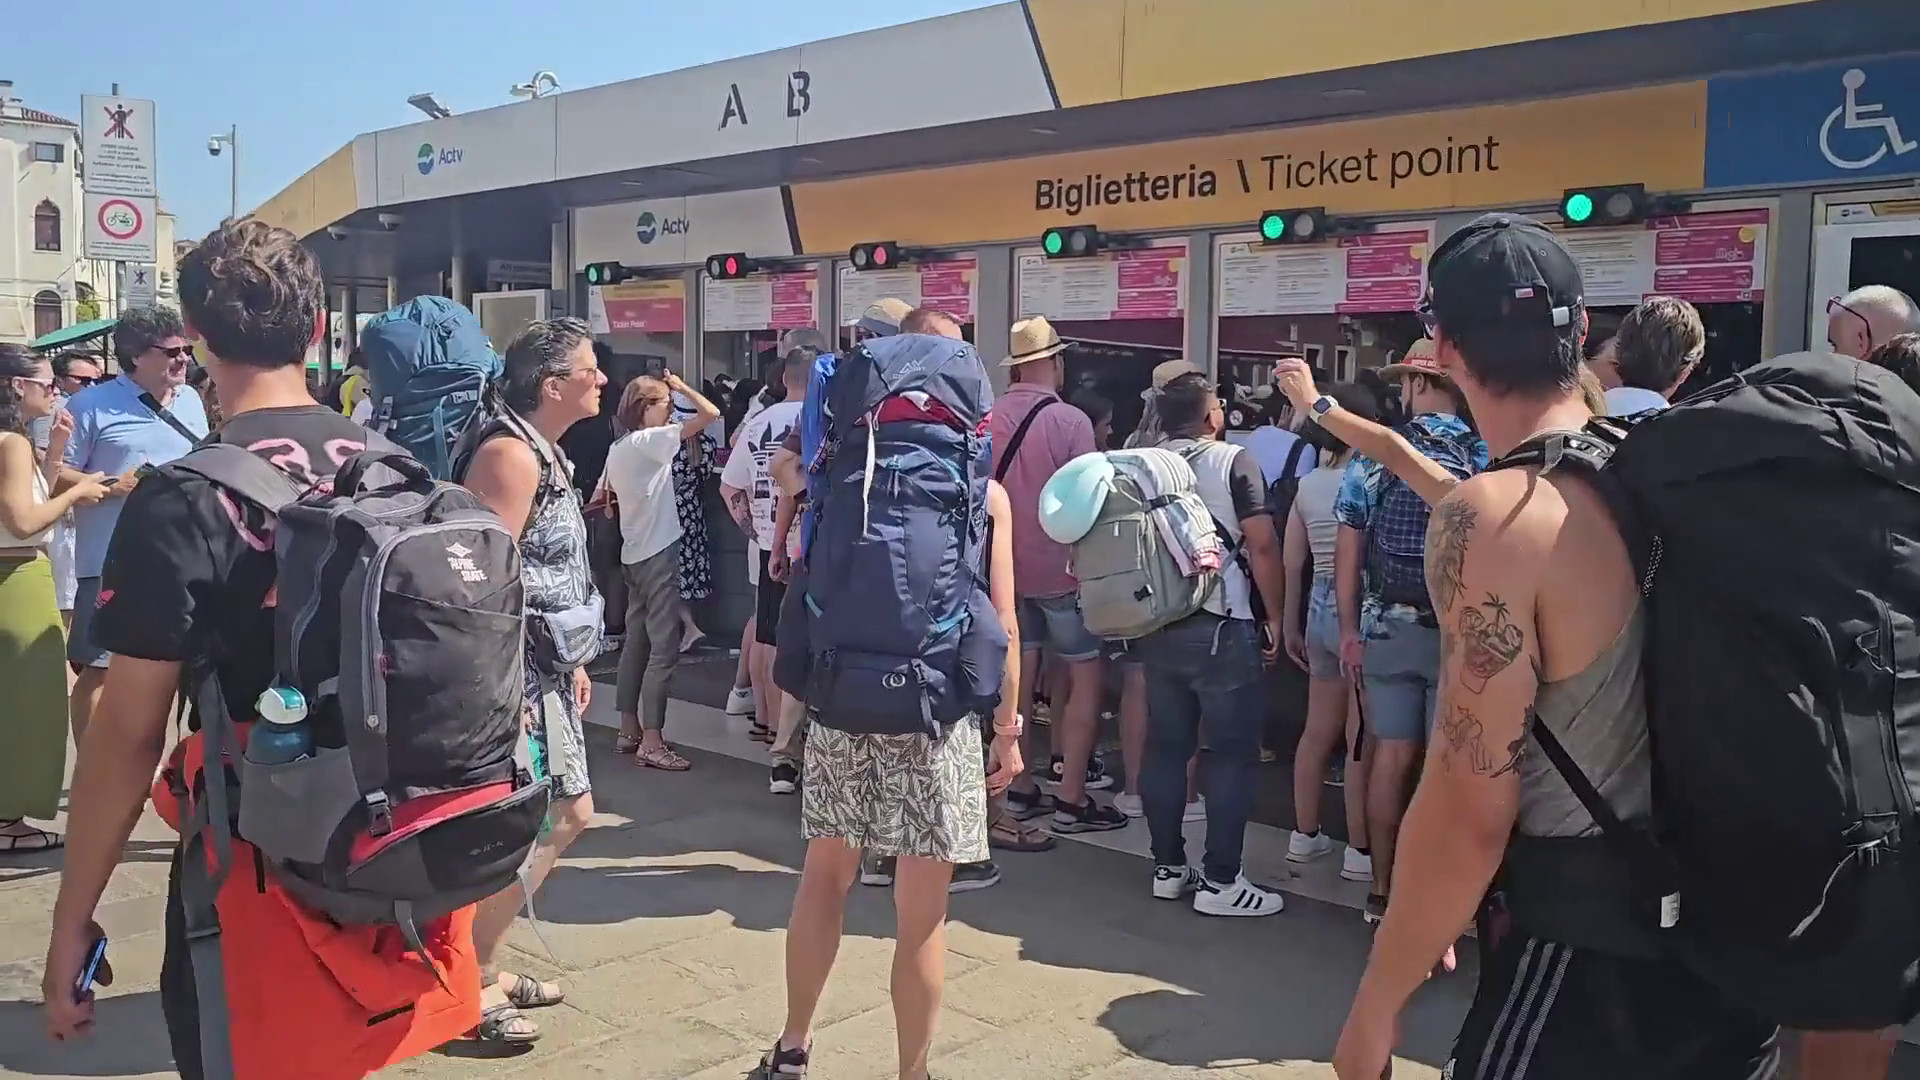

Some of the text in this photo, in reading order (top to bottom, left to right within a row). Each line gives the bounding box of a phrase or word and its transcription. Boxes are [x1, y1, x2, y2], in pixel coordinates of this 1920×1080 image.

[720, 71, 811, 129] A B
[438, 147, 463, 165] Actv
[1035, 164, 1217, 216] Biglietteria
[1260, 148, 1379, 192] Ticket
[1389, 135, 1500, 188] point
[661, 217, 690, 236] Actv
